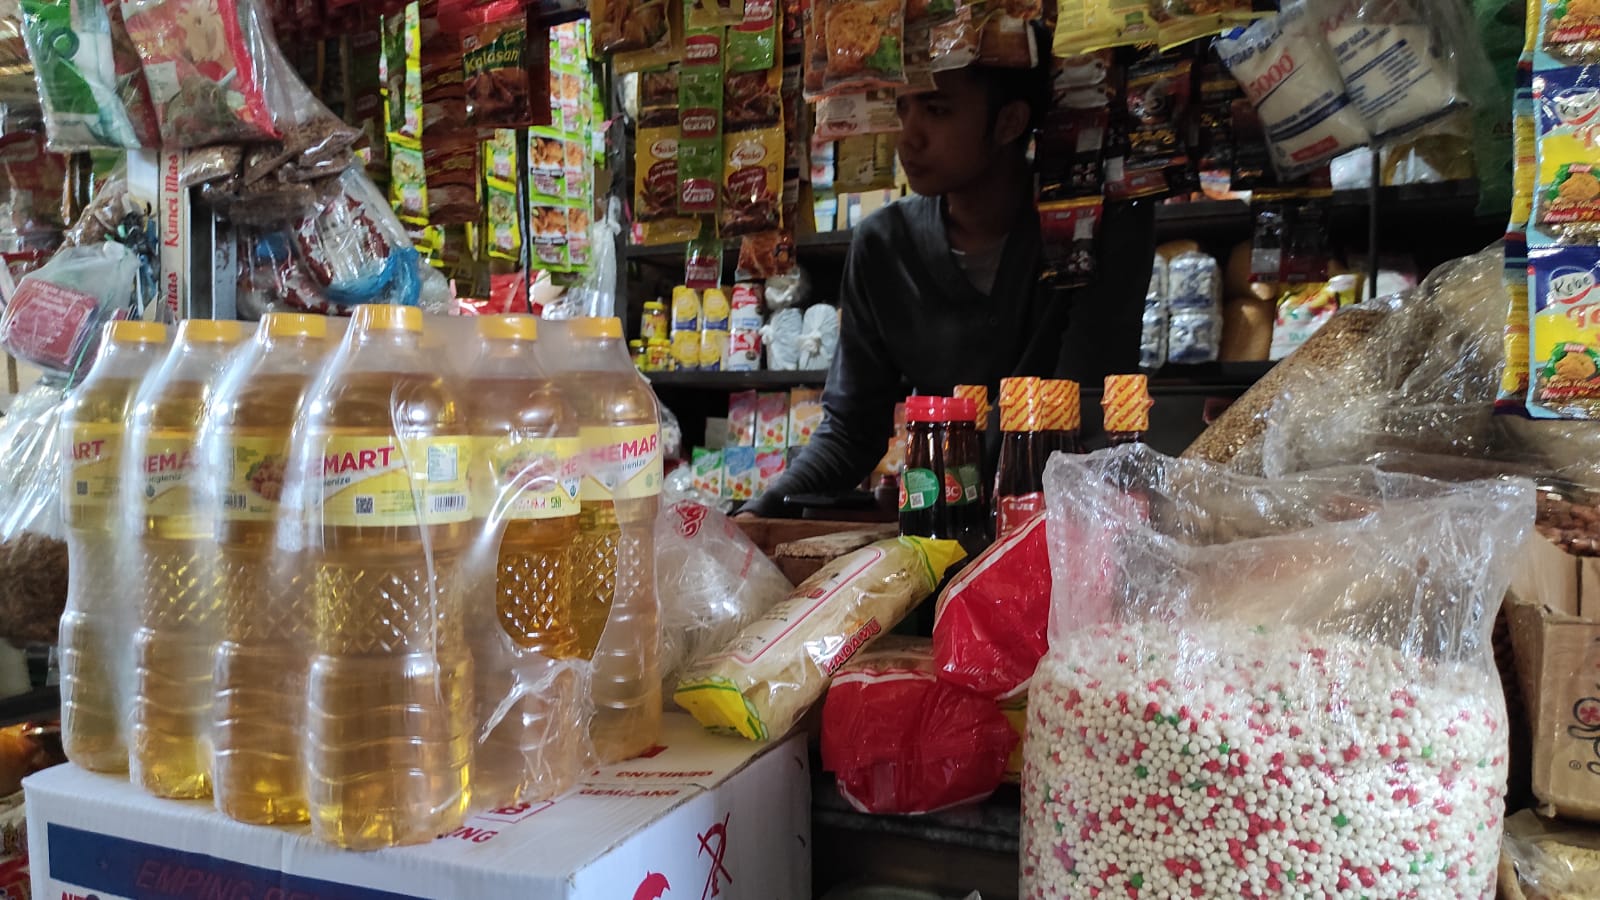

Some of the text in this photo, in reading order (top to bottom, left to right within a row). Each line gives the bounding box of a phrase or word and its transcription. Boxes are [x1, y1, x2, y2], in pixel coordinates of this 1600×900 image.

[464, 48, 520, 73] Kalasan
[164, 197, 180, 247] Kunci
[578, 787, 680, 797] GEMILANG
